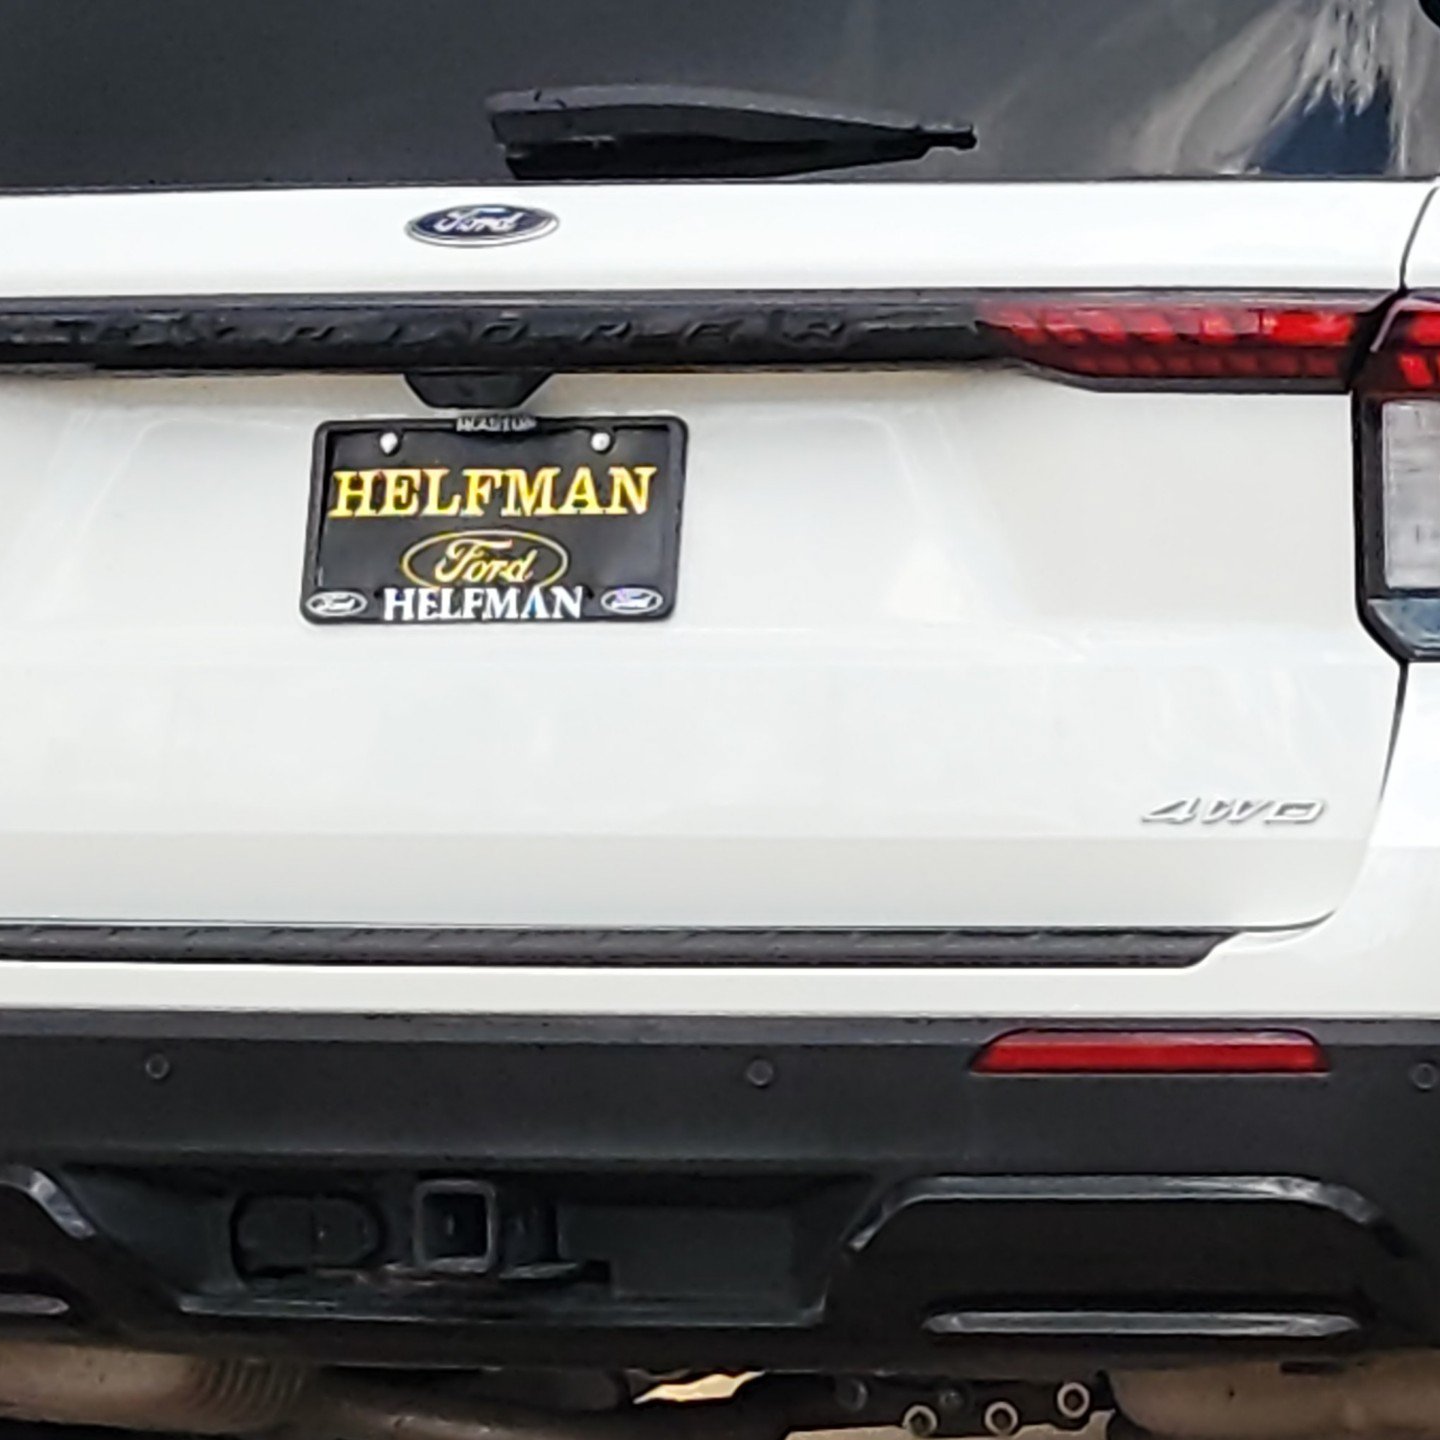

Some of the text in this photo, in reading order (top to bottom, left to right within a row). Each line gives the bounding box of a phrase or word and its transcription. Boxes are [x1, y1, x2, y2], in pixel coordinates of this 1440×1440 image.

[432, 206, 523, 234] Ford
[327, 465, 658, 518] HELFMAN
[434, 538, 539, 584] Ford
[382, 584, 584, 622] HELFMAN
[1140, 796, 1327, 825] 4WD
